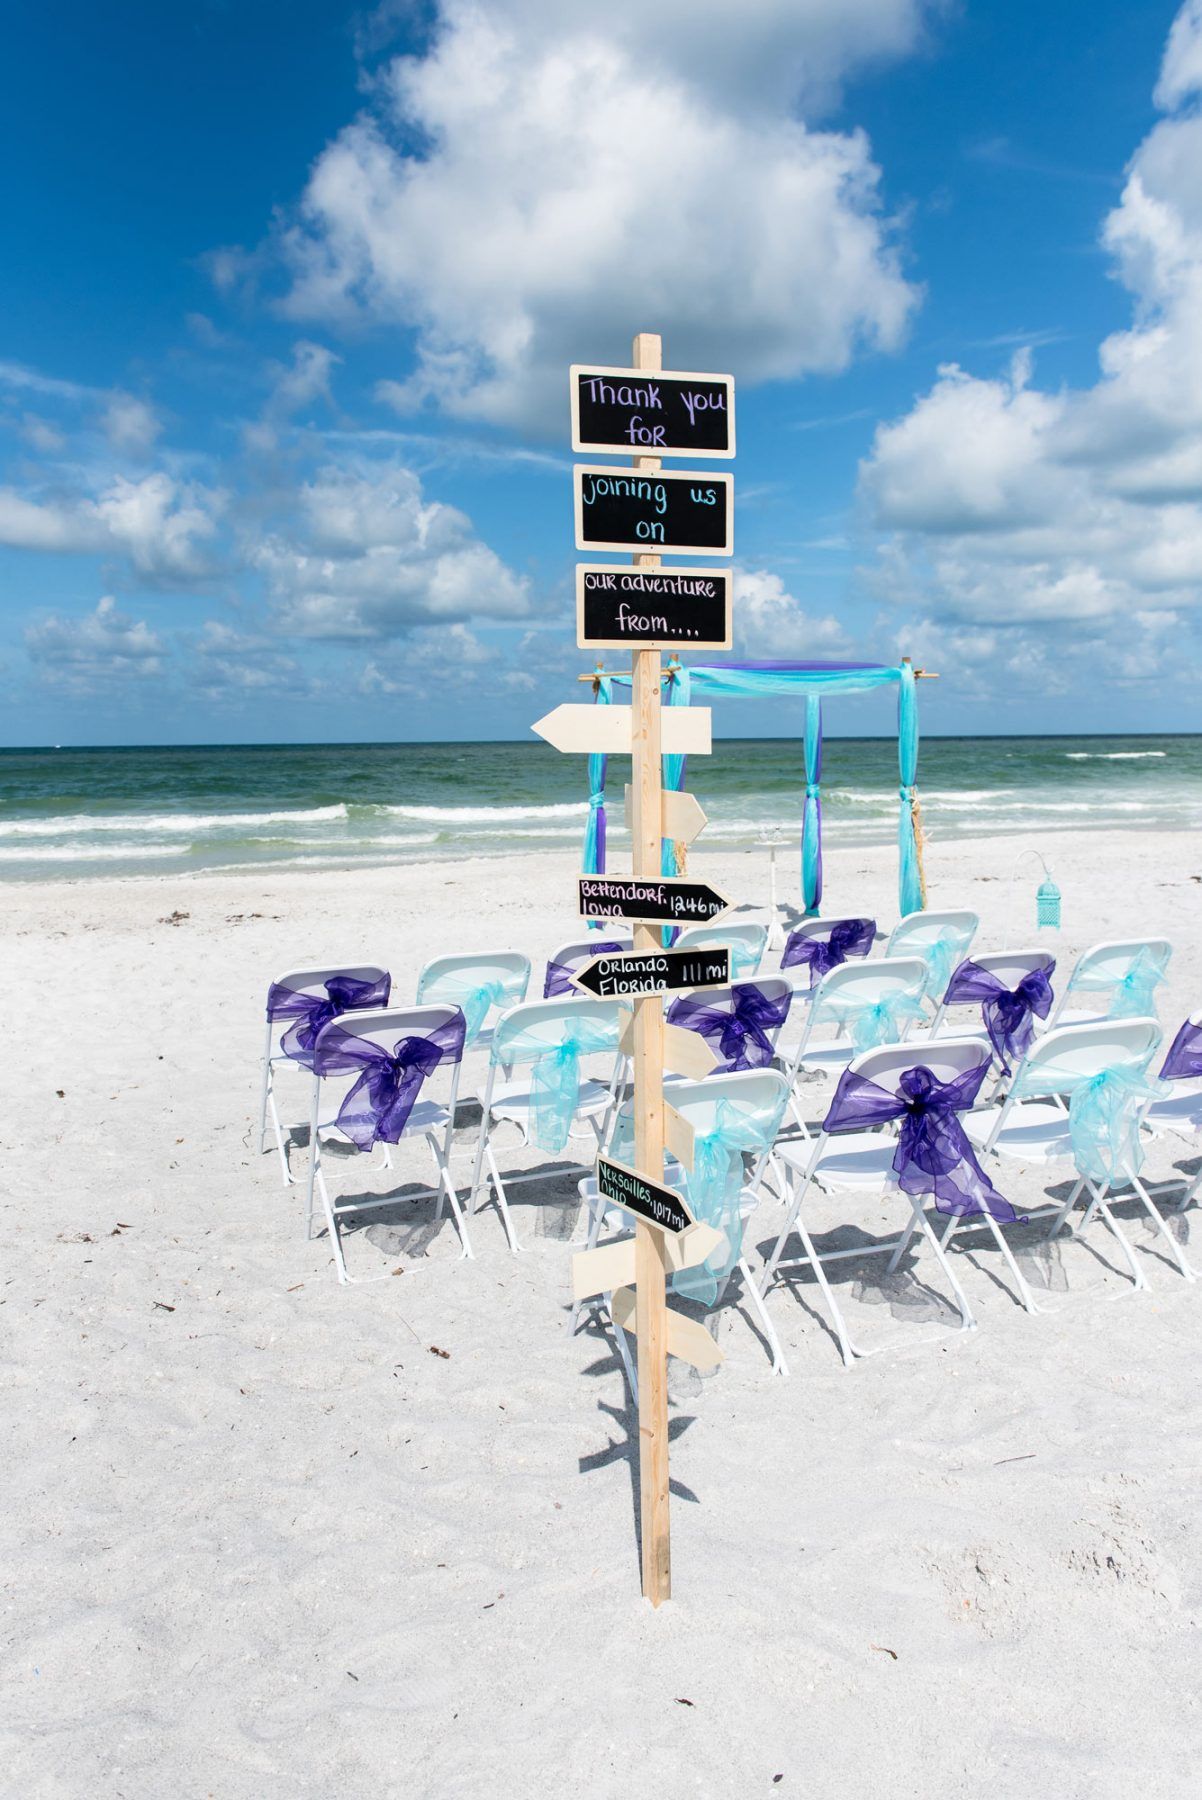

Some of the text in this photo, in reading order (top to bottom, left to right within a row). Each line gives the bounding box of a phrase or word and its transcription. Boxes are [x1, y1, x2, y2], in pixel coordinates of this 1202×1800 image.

[580, 377, 726, 426] Thank you
[583, 475, 716, 514] joining us
[636, 521, 665, 543] on
[582, 899, 624, 917] Iowa
[709, 901, 724, 914] mi
[683, 963, 701, 982] 111
[706, 959, 728, 980] mi
[672, 1214, 685, 1229] mi
